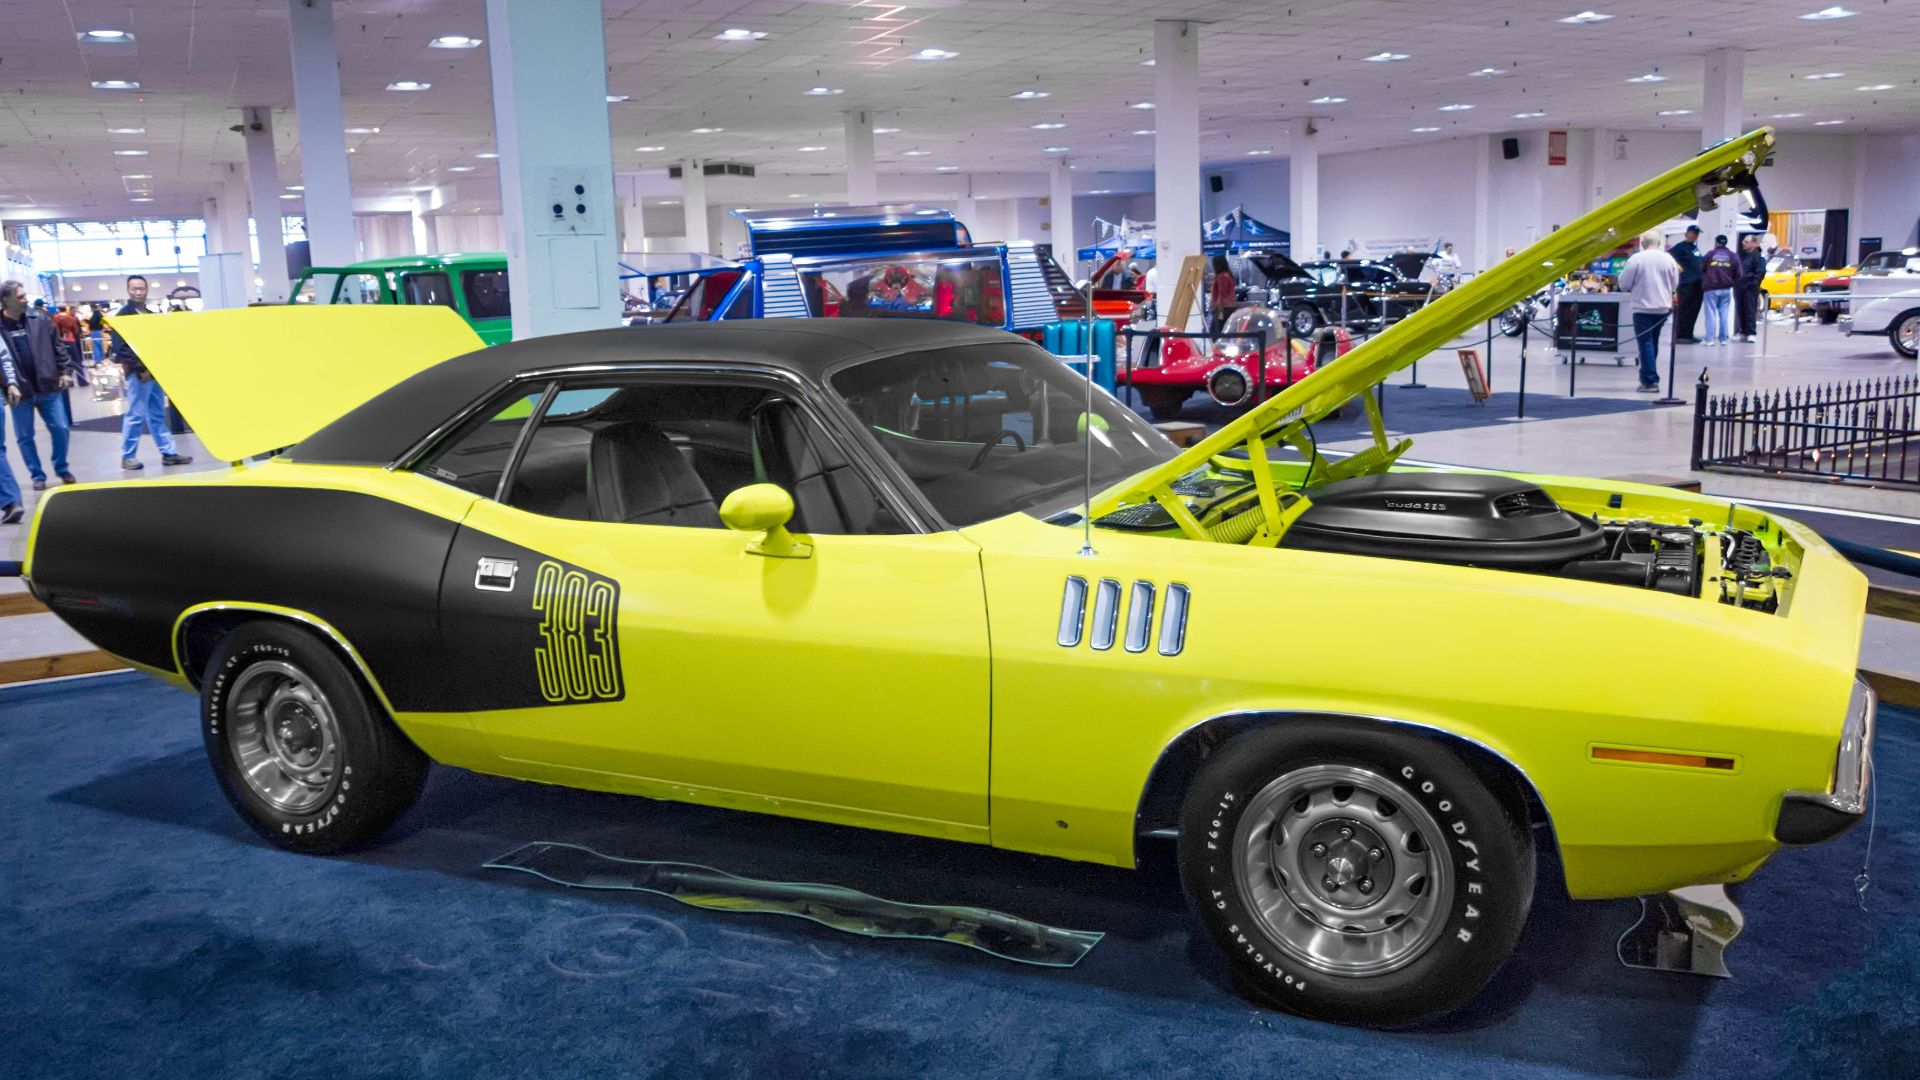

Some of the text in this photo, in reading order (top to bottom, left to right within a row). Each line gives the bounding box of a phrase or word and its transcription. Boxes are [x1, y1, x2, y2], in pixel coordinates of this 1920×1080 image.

[532, 560, 620, 702] 383
[211, 674, 226, 735] POLYGLAS
[226, 656, 238, 668] GT
[282, 765, 353, 835] GOODYEAR
[1207, 791, 1235, 850] F60-15
[1401, 766, 1483, 942] GOODYEAR
[1211, 888, 1227, 910] GT
[1228, 923, 1306, 991] POLYGLAS
